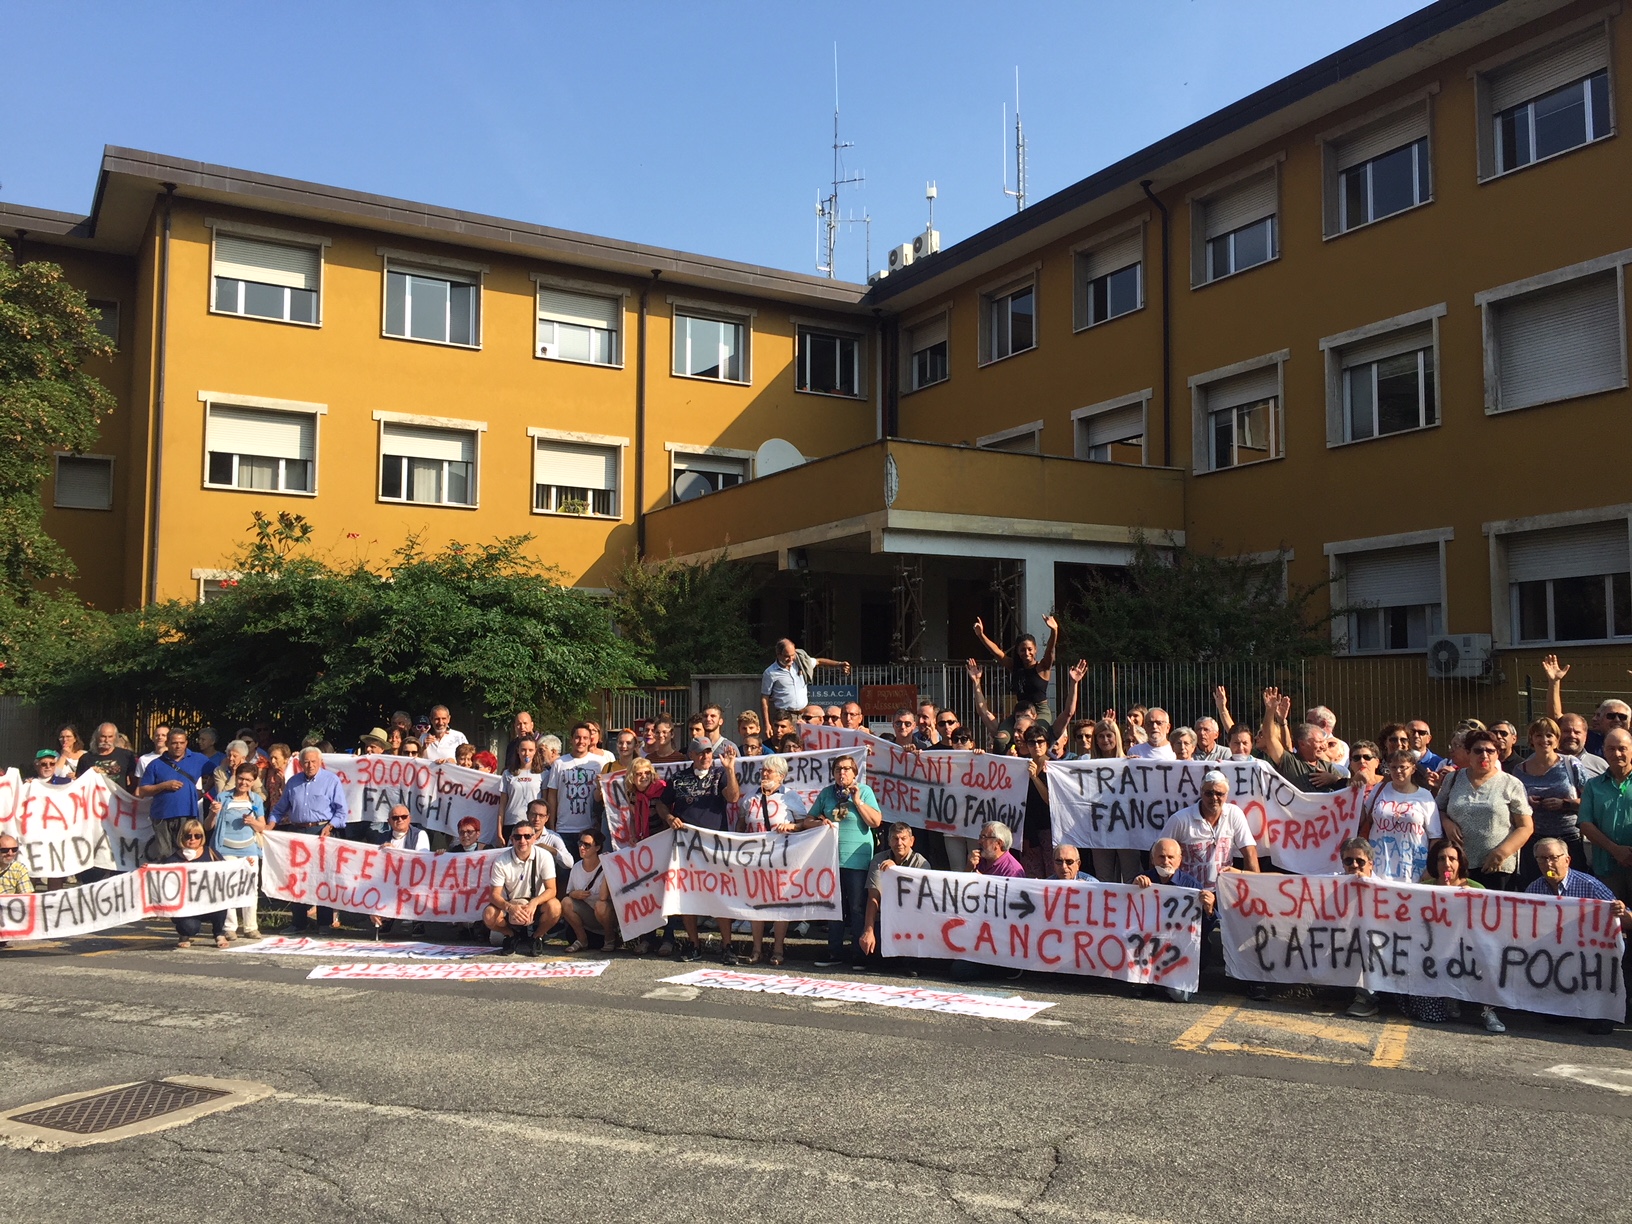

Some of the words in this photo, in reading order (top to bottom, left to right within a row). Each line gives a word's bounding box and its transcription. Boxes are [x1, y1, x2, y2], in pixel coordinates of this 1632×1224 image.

[724, 698, 734, 709] 2
[355, 758, 431, 789] 30.000
[562, 767, 597, 784] JUST
[889, 746, 953, 784] MANI
[960, 758, 1012, 790] dalle
[20, 785, 139, 836] FANGH
[363, 788, 453, 826] FANGHI
[567, 784, 592, 799] DO
[570, 799, 588, 814] IT
[926, 787, 957, 824] NO
[964, 795, 1026, 834] FANGHI
[289, 835, 494, 891] DIFENDIAM
[614, 844, 655, 884] NO
[671, 828, 790, 869] FANGHI
[42, 875, 136, 933] FANGHI
[146, 871, 182, 904] NO
[187, 869, 256, 904] FANGHI
[395, 883, 493, 916] PULITA
[743, 866, 837, 903] UNESCO
[896, 875, 1009, 919] FANGHI
[1231, 877, 1273, 918] la
[1279, 876, 1389, 923] SALUTE
[1420, 890, 1452, 927] di
[1446, 937, 1483, 980] di
[1500, 945, 1620, 994] POCHI
